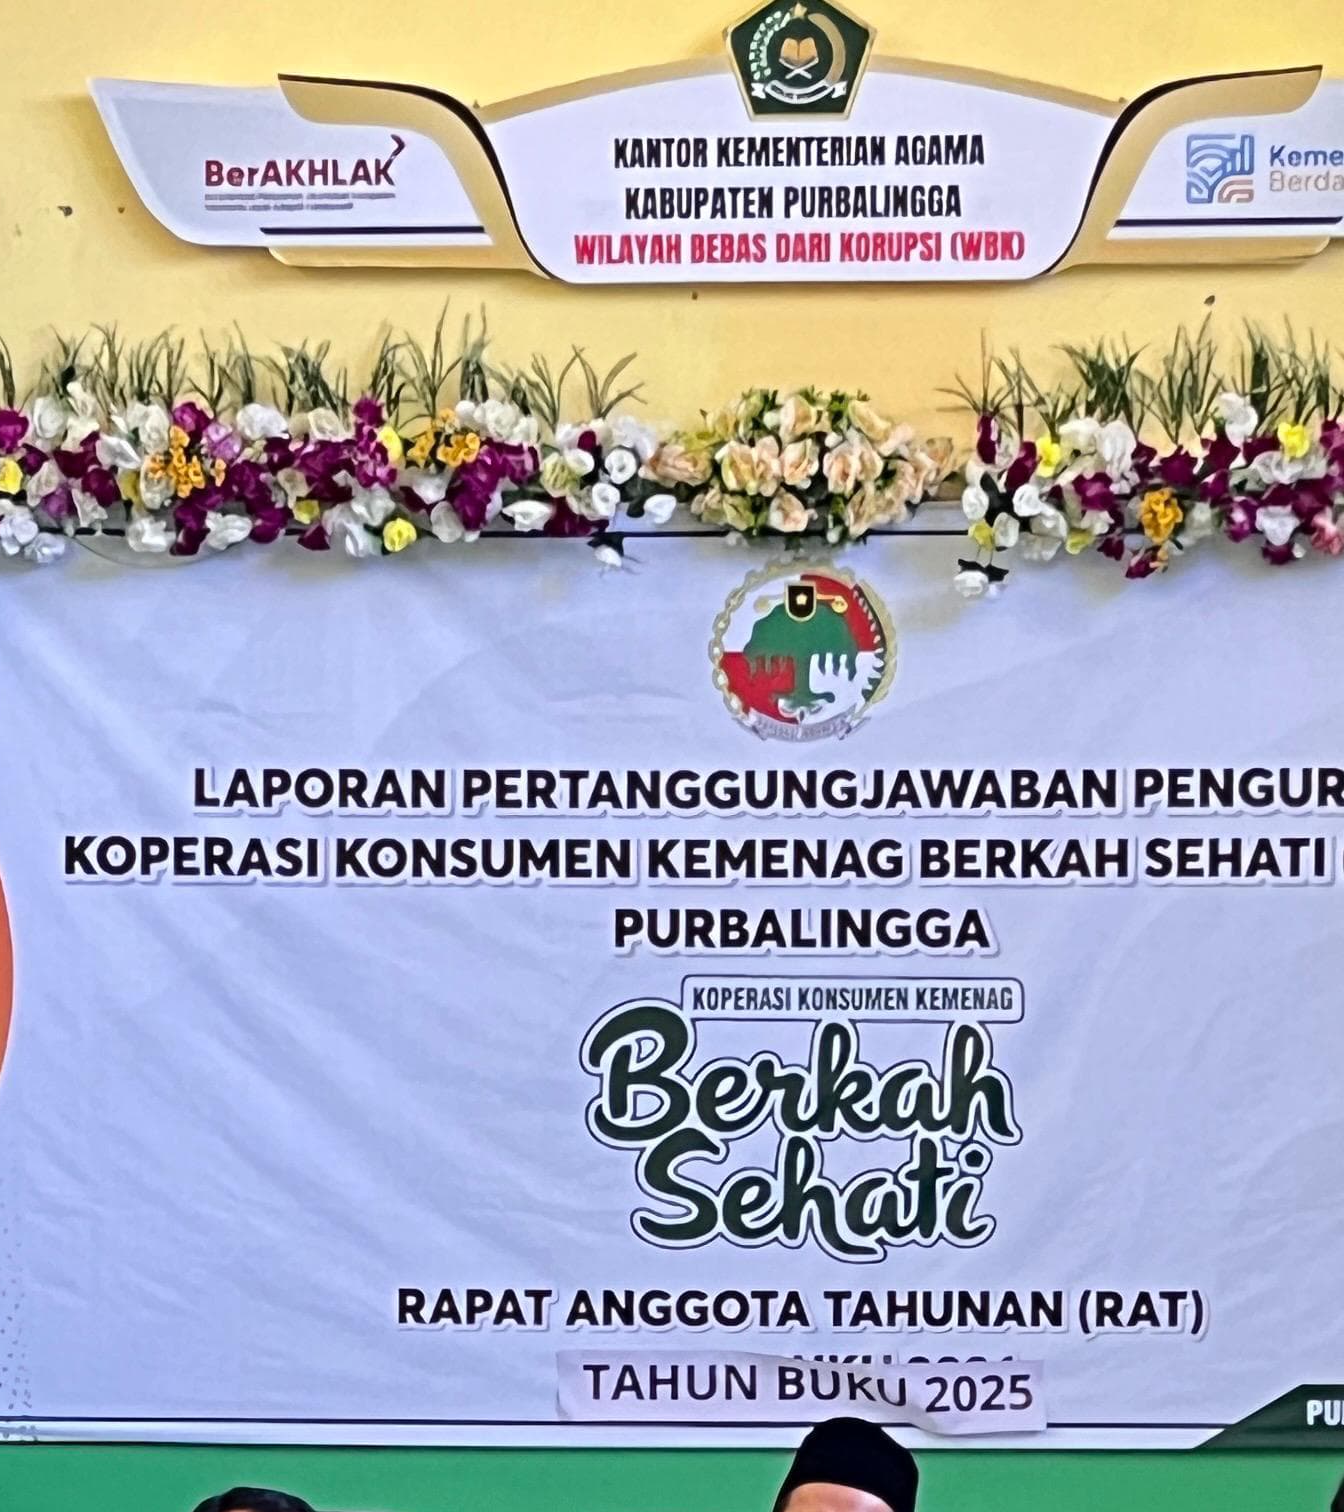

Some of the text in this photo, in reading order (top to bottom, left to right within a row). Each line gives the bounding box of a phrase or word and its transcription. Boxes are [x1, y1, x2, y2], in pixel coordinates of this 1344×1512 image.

[205, 143, 405, 187] BerAKHLAK
[614, 135, 984, 168] KANTOR KEMENTERIAN AGAMA
[625, 185, 961, 219] KABUPATEN PURBALINGGA
[574, 231, 1025, 264] WILAYAH BEBAS DARI KORUPSI (WBK)
[194, 768, 446, 809] LAPORAN
[463, 768, 1118, 809] PERTANGGUNGJAWABAN
[64, 836, 320, 877] KOPERASI
[336, 836, 631, 878] KONSUMEN
[648, 838, 903, 878] KEMENAG
[920, 838, 1129, 878] BERKAH
[1145, 837, 1325, 878] SEHATI
[614, 908, 989, 948] PURBALINGGA
[693, 987, 1013, 1011] KOPERASI KONSUMEN KEMENAG
[586, 1004, 1019, 1143] Berkah
[636, 1127, 993, 1256] Sehati
[398, 1288, 1208, 1334] RAPAT ANGGOTA TAHUNAN (RAT)
[583, 1363, 1034, 1412] TAHUN BUKU 2025
